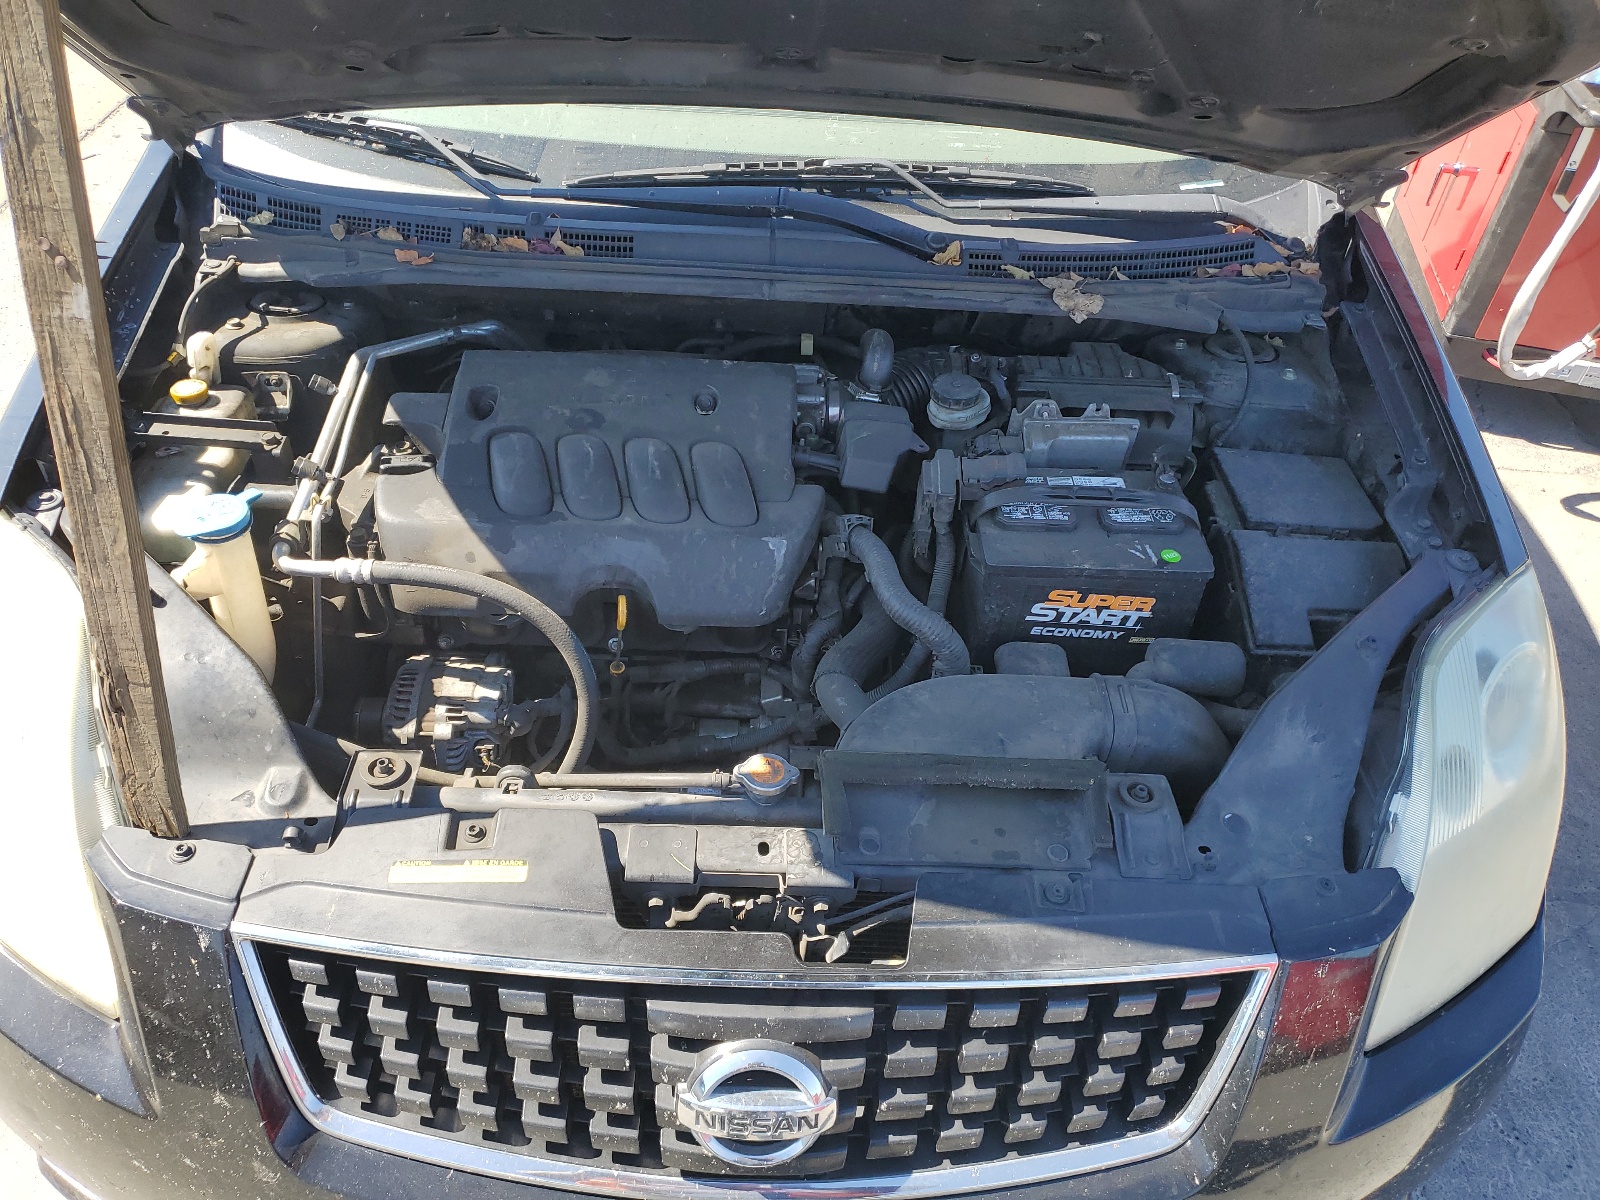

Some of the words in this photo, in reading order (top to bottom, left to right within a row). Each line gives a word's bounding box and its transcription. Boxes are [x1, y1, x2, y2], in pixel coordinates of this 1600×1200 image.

[1044, 589, 1157, 612] SUPER
[1025, 602, 1153, 627] START
[1030, 626, 1126, 640] ECONOMY
[694, 1110, 820, 1135] NISSAN
